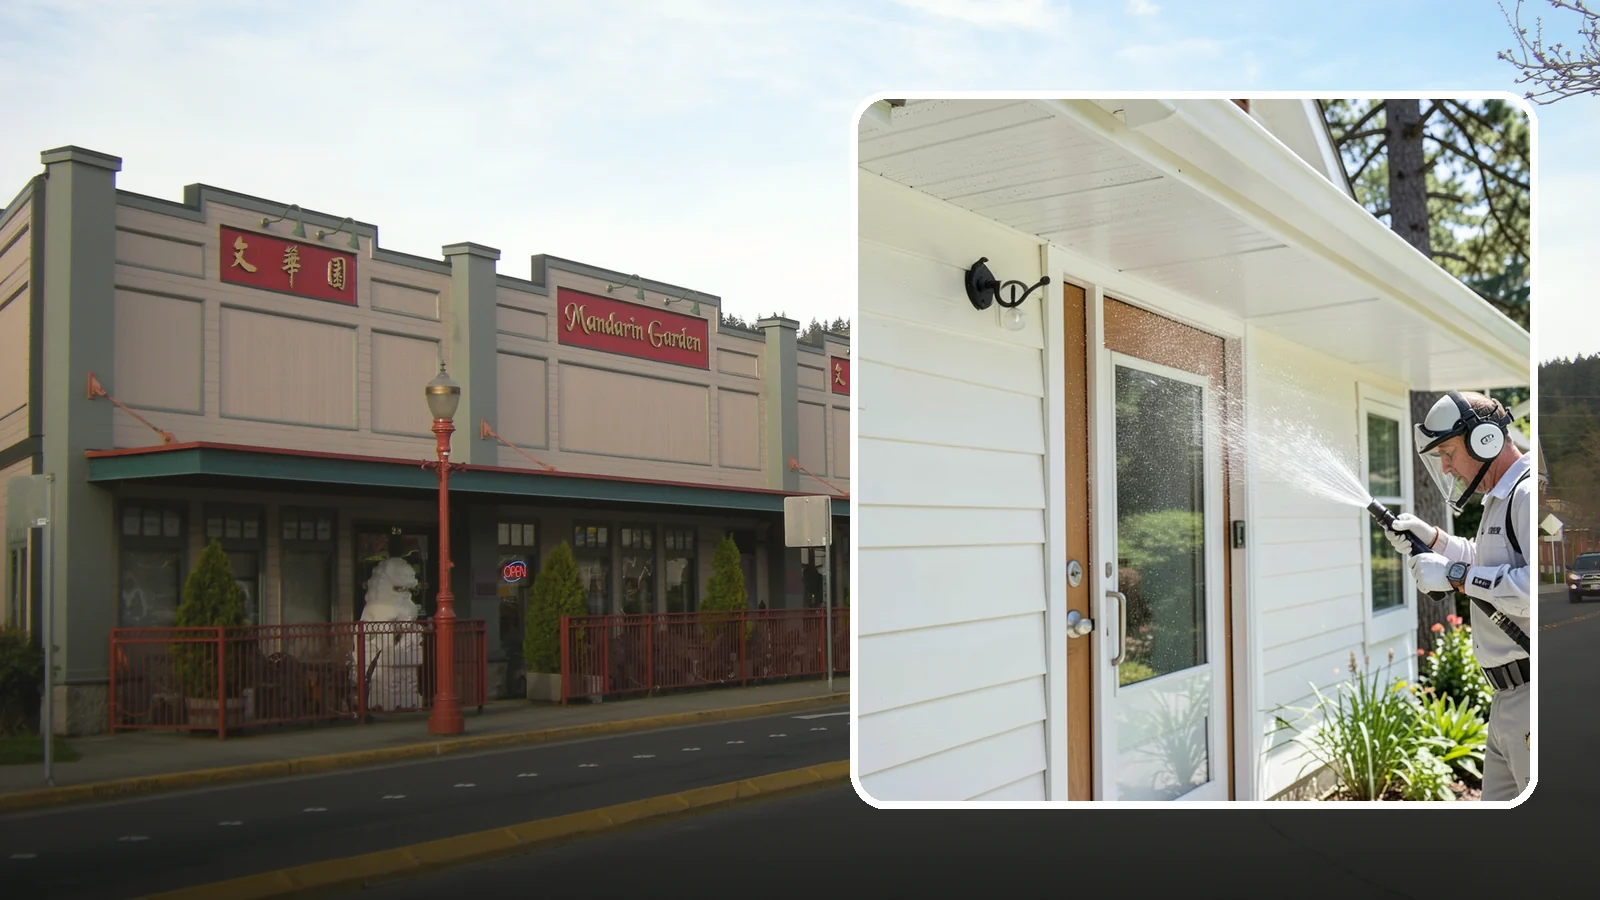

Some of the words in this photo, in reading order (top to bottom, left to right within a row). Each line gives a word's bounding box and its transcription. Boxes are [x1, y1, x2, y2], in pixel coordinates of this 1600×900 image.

[231, 236, 345, 291] 文華園
[564, 302, 644, 341] Mandarin
[647, 320, 701, 352] Garden
[835, 363, 846, 386] 文
[503, 565, 527, 578] OPEN
